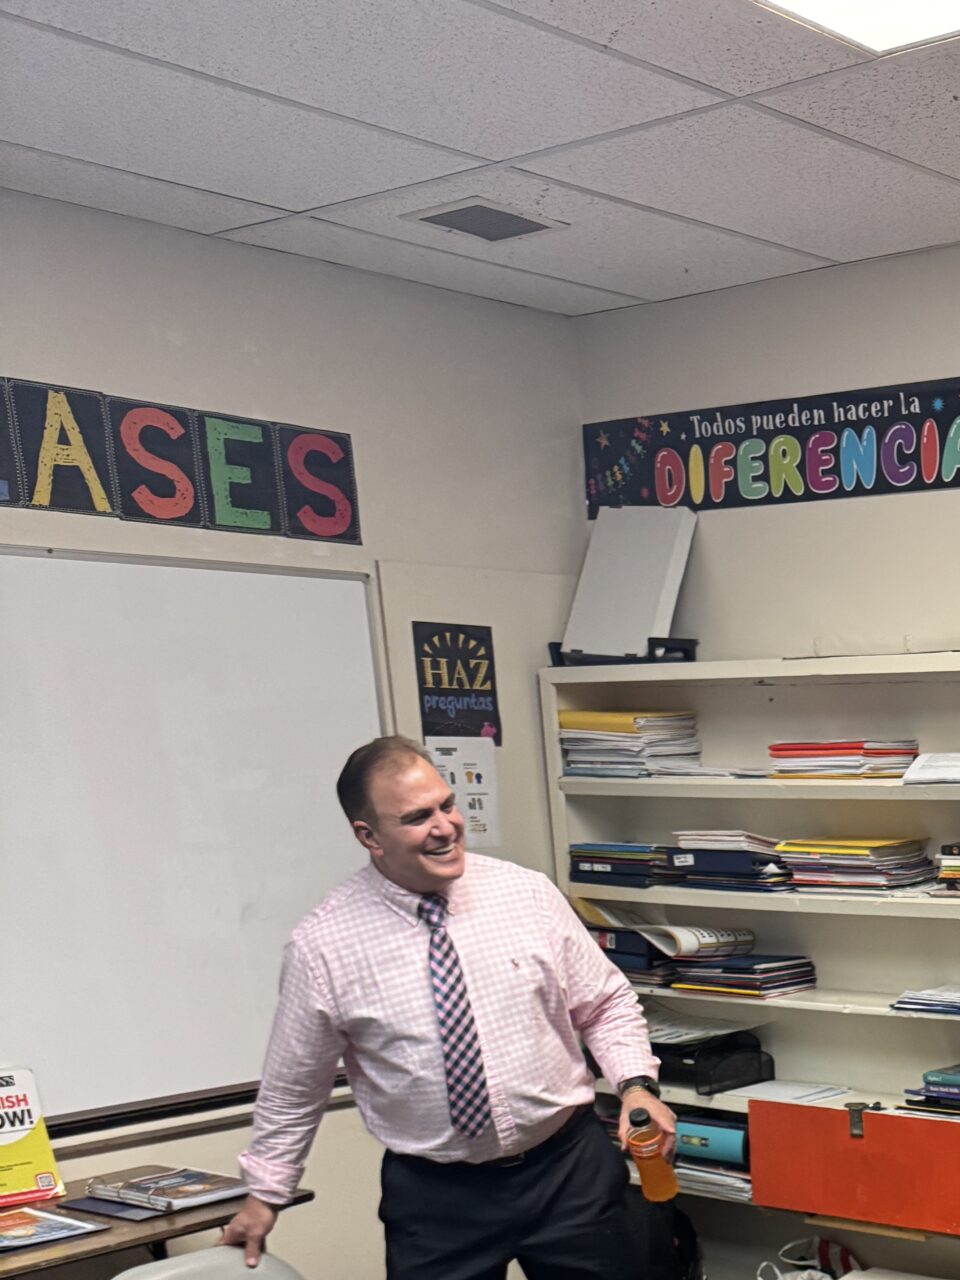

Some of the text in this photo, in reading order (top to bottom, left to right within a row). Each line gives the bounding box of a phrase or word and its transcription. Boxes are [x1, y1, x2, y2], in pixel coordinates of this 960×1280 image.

[690, 392, 921, 438] Todos pueden hacer la
[0, 389, 352, 537] ASES
[421, 656, 492, 690] HAZ
[423, 693, 494, 718] preguntas
